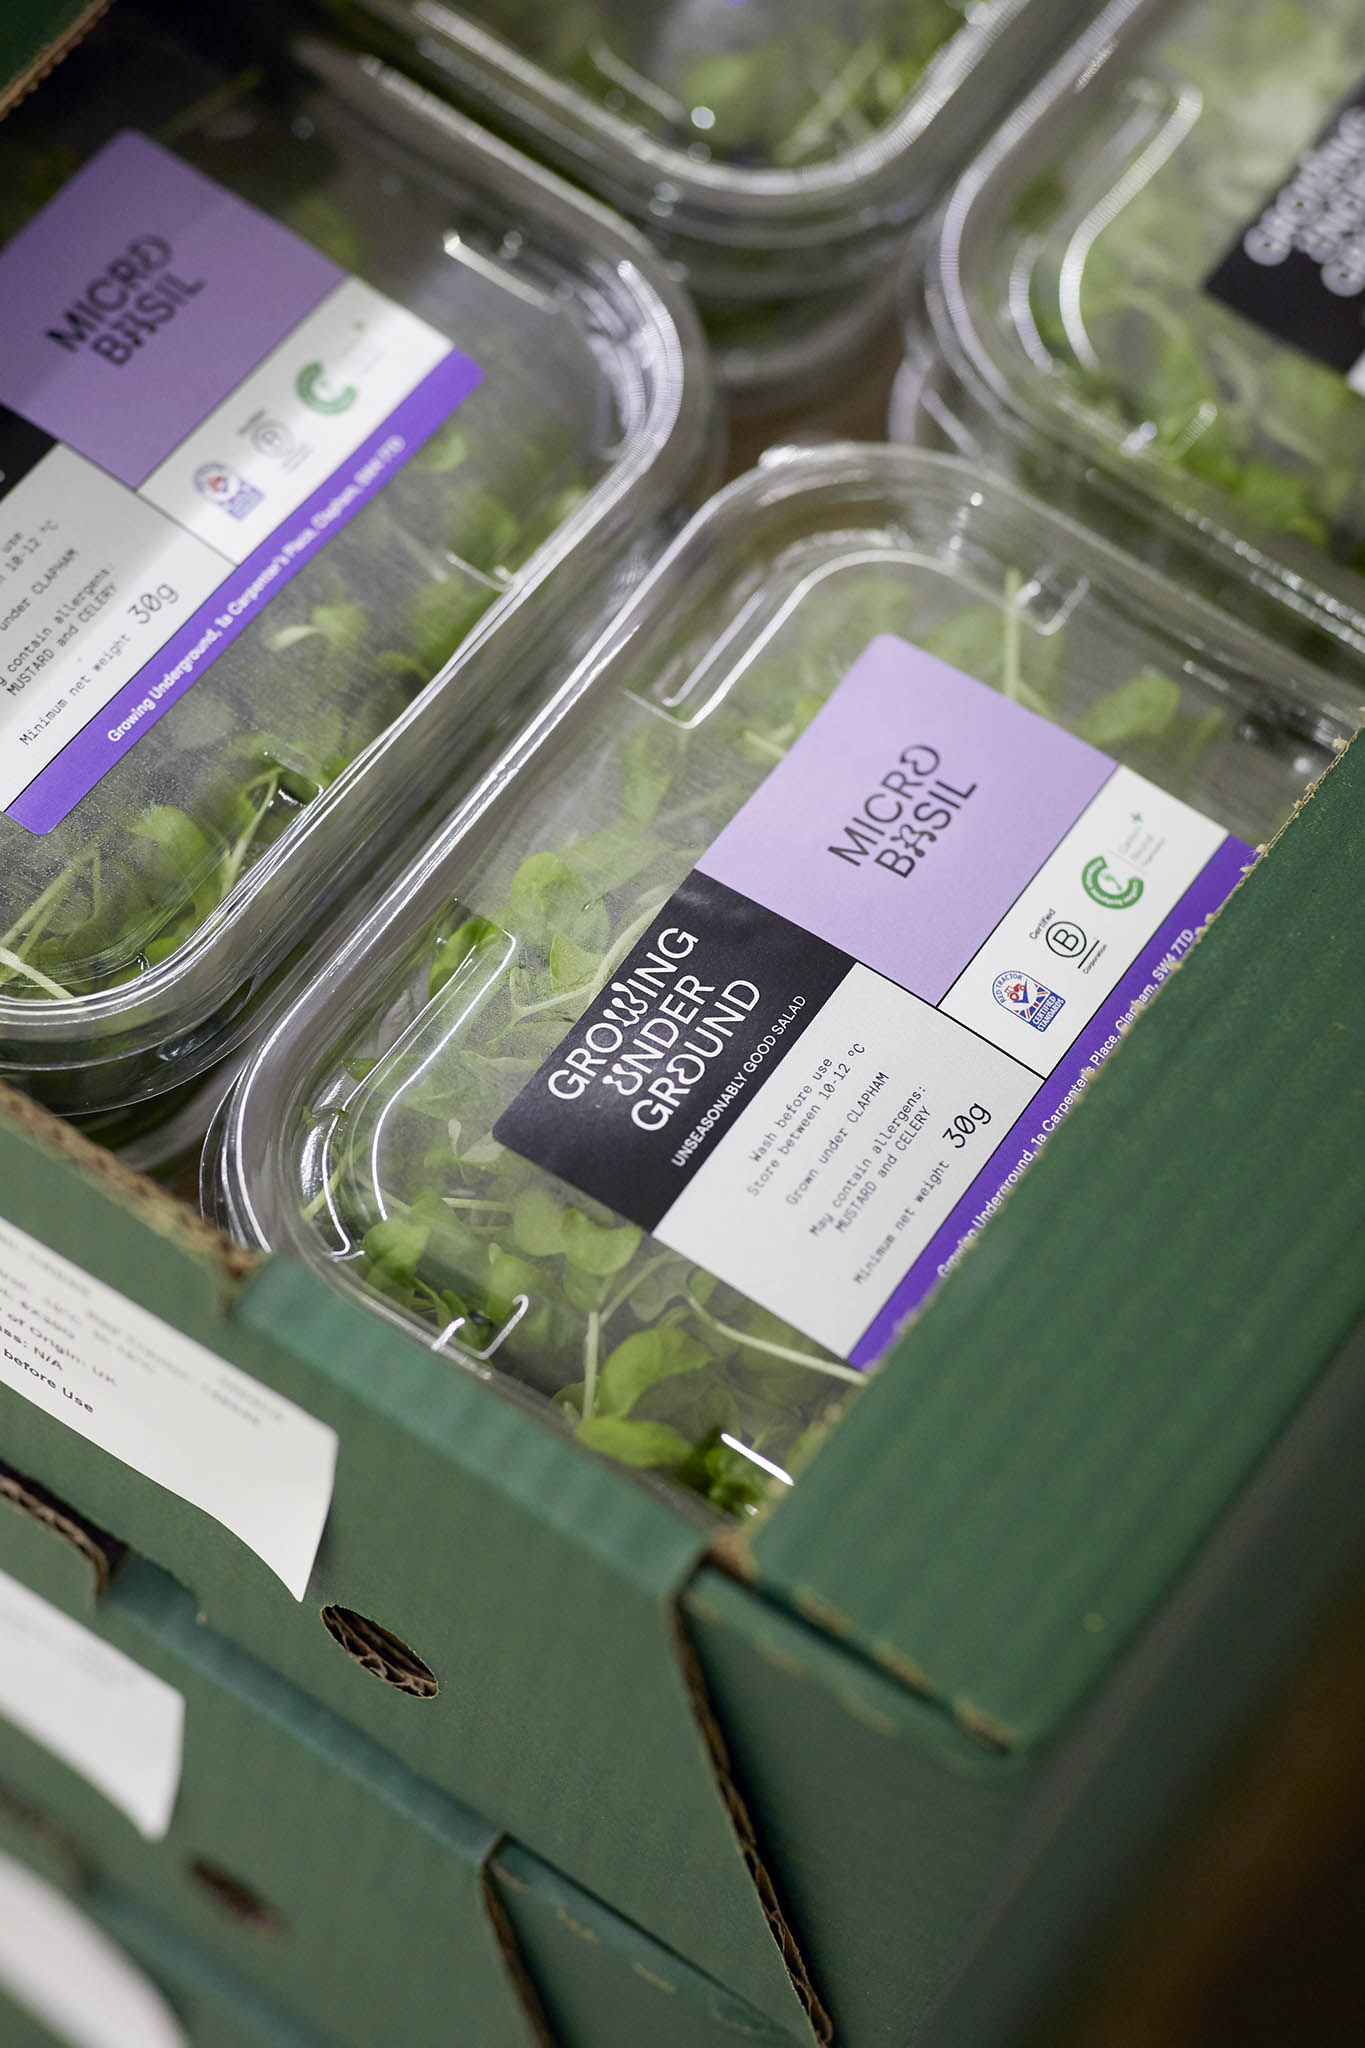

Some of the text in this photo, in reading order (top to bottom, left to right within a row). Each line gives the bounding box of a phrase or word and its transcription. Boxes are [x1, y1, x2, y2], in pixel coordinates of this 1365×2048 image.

[45, 234, 173, 352] MICRO
[6, 648, 55, 696] MUSTARD
[57, 624, 79, 647] and
[7, 626, 53, 674] contain
[19, 582, 180, 746] Minimum net weight 30g
[107, 696, 156, 743] Growing
[827, 745, 940, 867] MICRO
[874, 780, 978, 878] BASIL
[1029, 908, 1057, 940] Certified
[1053, 928, 1080, 951] B
[548, 927, 699, 1100] GROWING
[602, 974, 716, 1096] UNDER
[631, 979, 761, 1131] GROUND
[1032, 995, 1058, 1026] CERTIFIED
[1038, 999, 1064, 1032] STANDARDS
[672, 995, 806, 1167] UNSEASONABLY GOOD SALAD
[746, 1159, 781, 1197] Store
[779, 1103, 822, 1155] between
[818, 1062, 851, 1100] 10-12
[749, 1057, 833, 1163] Wash before use
[785, 1071, 890, 1206] Grown under CLAPHAM
[1030, 1133, 1048, 1147] 1a
[1089, 1032, 1122, 1066] Place,
[808, 1085, 927, 1238] May contain allergens:
[834, 1105, 933, 1234] MUSTARD and CELERY
[852, 1102, 993, 1285] Minimum net weight 30g
[4, 1348, 94, 1413] before Use
[34, 1346, 63, 1371] N/A
